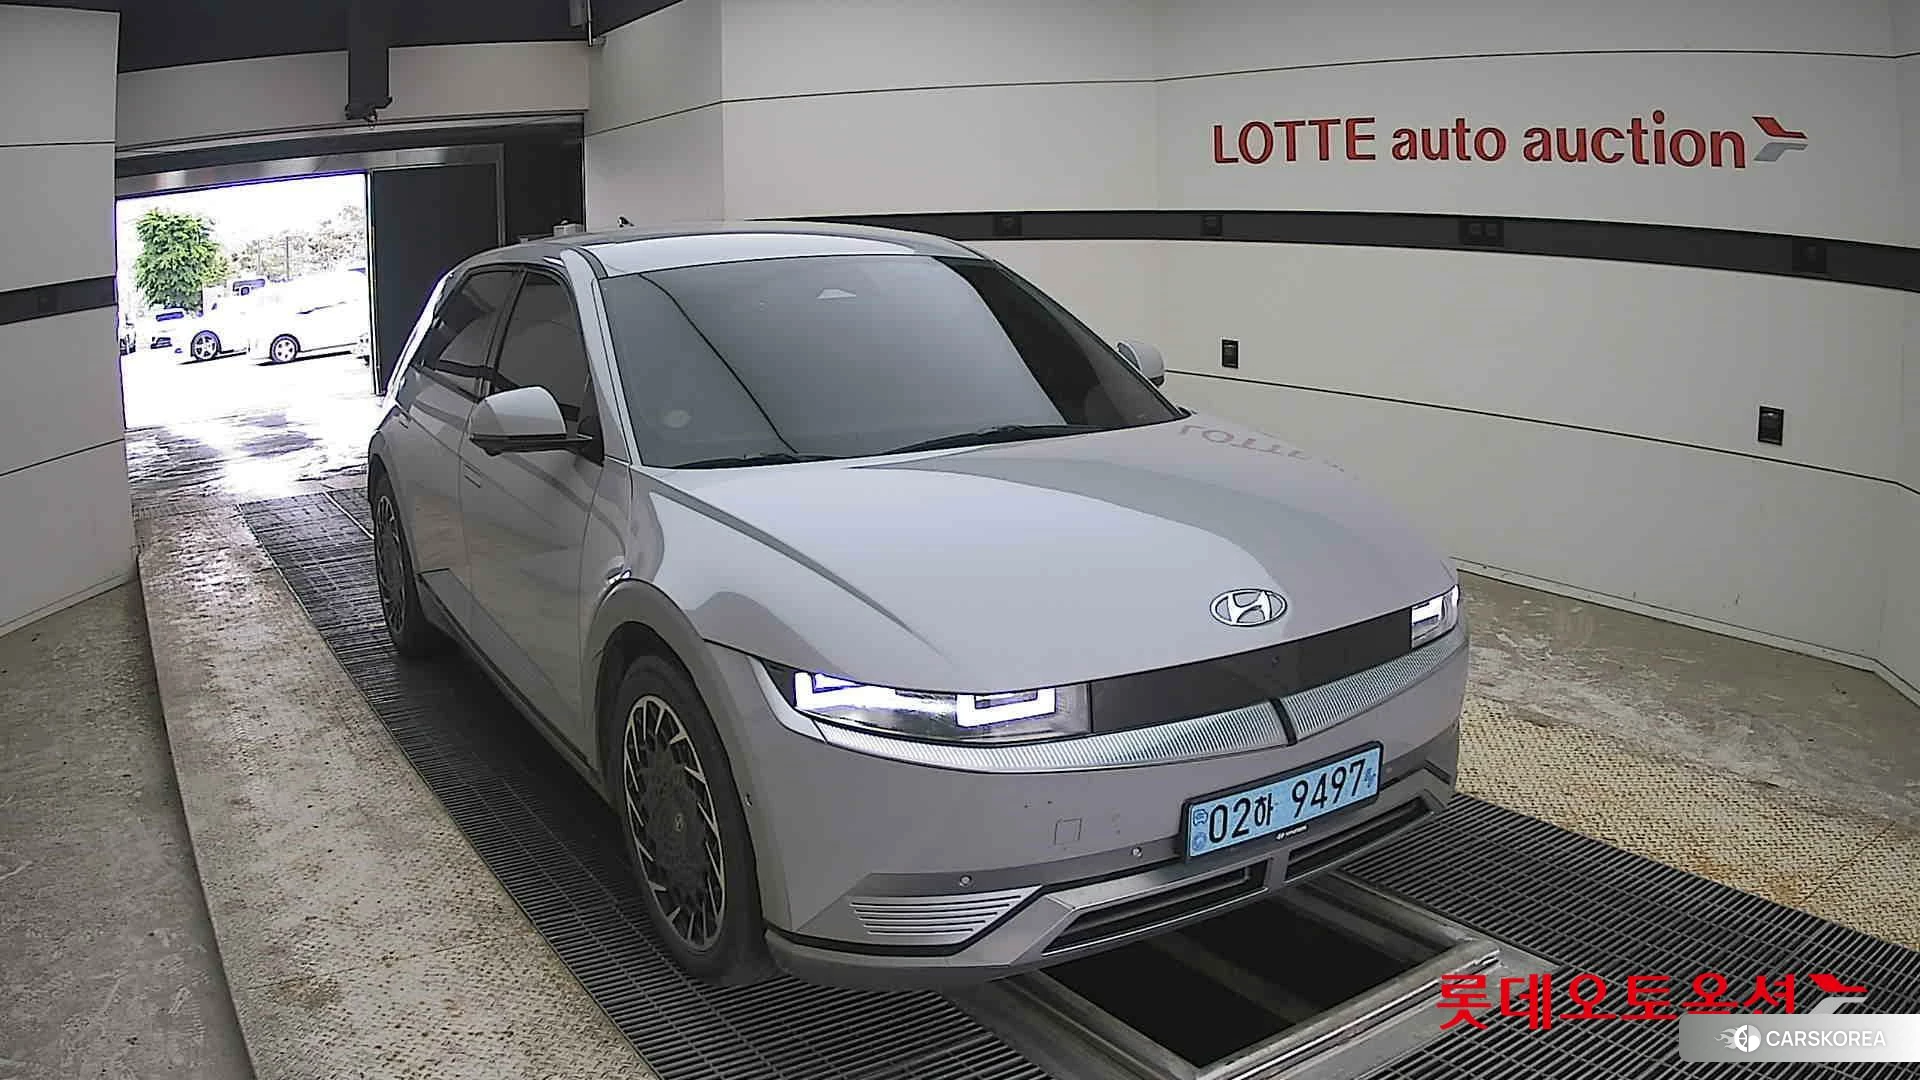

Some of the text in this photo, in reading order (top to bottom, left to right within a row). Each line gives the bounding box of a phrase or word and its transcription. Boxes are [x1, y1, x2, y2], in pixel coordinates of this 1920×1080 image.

[1212, 110, 1746, 169] LOTTE auto auction
[1208, 758, 1366, 844] 02하 9497
